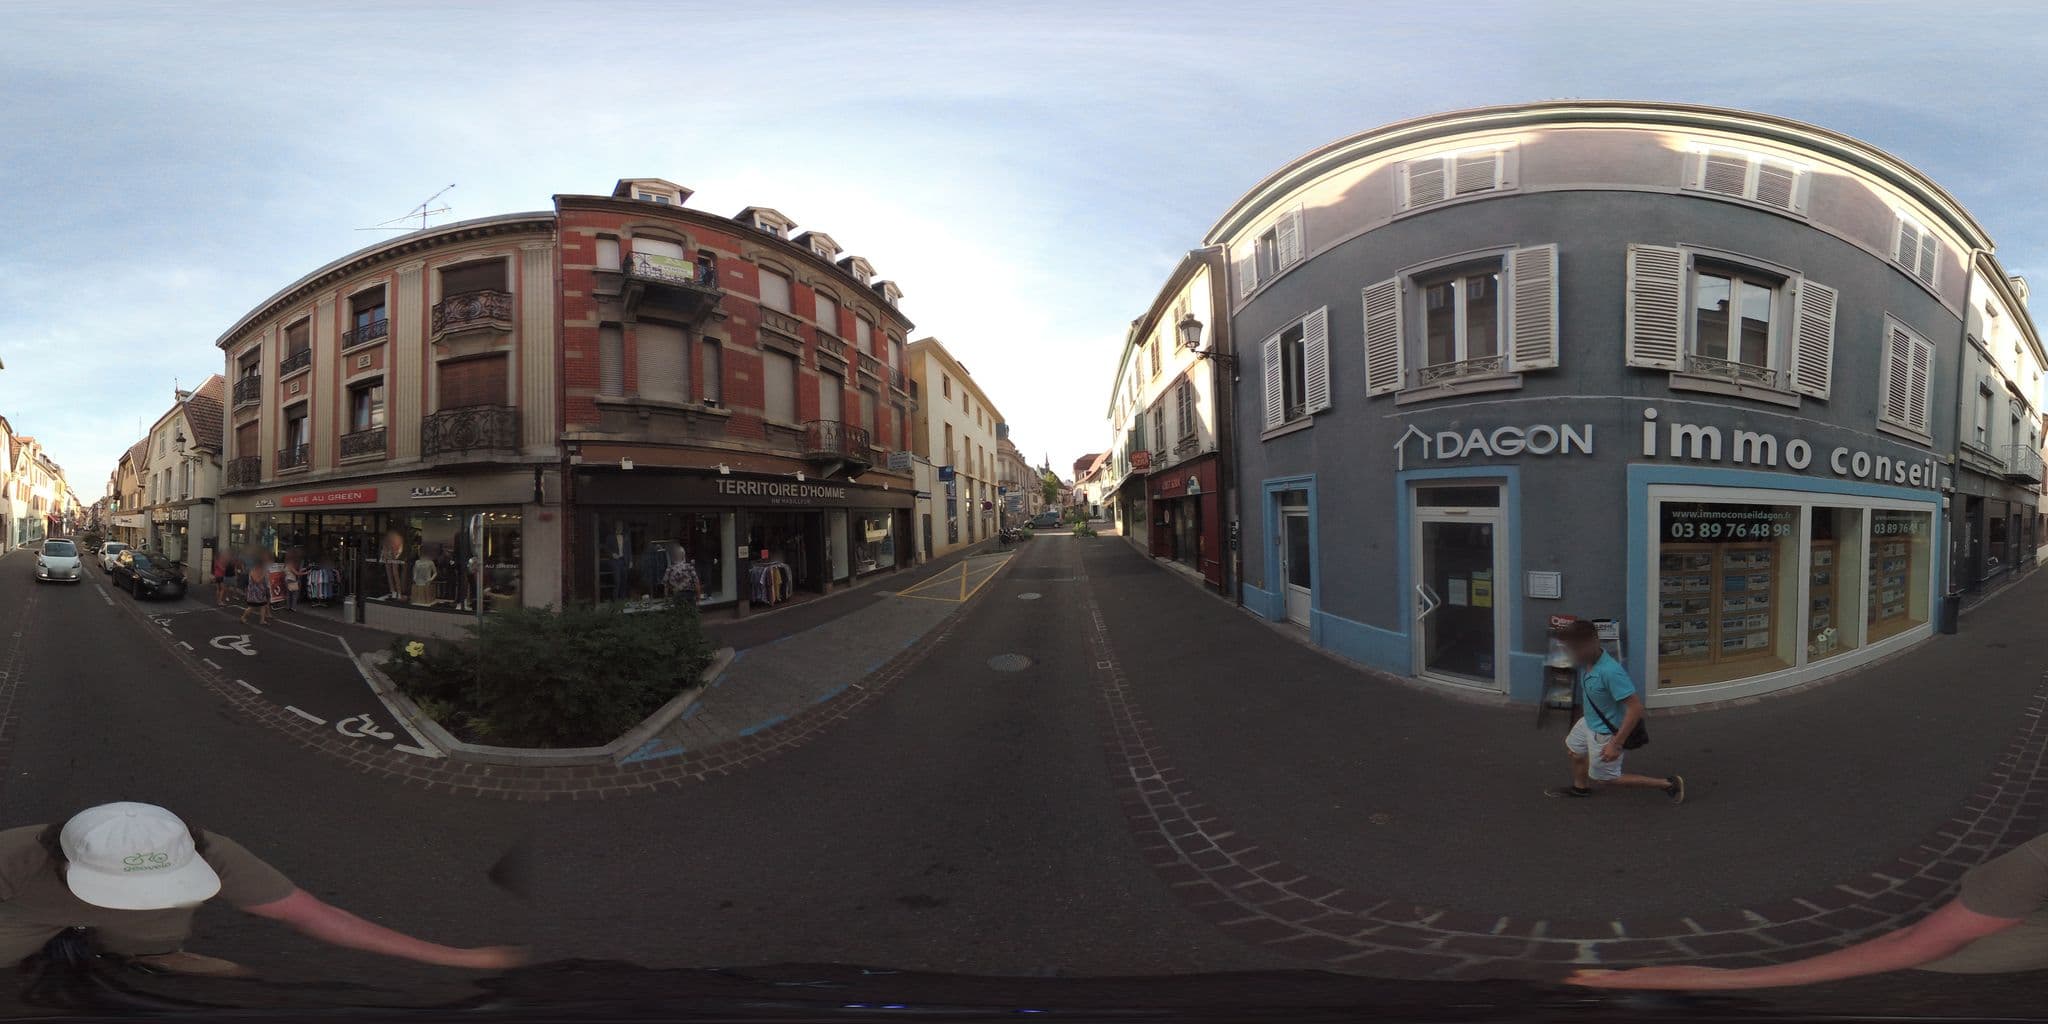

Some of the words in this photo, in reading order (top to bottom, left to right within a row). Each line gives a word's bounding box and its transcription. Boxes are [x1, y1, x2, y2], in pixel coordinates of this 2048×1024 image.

[1436, 423, 1593, 460] DAGON
[1642, 407, 1812, 470] immo
[1830, 446, 1938, 489] conseil
[716, 480, 798, 497] TERRITOIRE
[800, 485, 845, 498] D'HOMME
[289, 496, 309, 504] MISE
[327, 492, 362, 501] GREEN
[1671, 509, 1792, 521] www.immoconseildagon.fr
[1671, 522, 1695, 538] 03
[1699, 522, 1722, 538] 89
[1726, 523, 1747, 538] 76
[1750, 523, 1770, 538] 48
[1773, 523, 1792, 537] 98
[1874, 523, 1886, 534] 03
[1887, 523, 1898, 534] 89
[1898, 523, 1908, 534] 76
